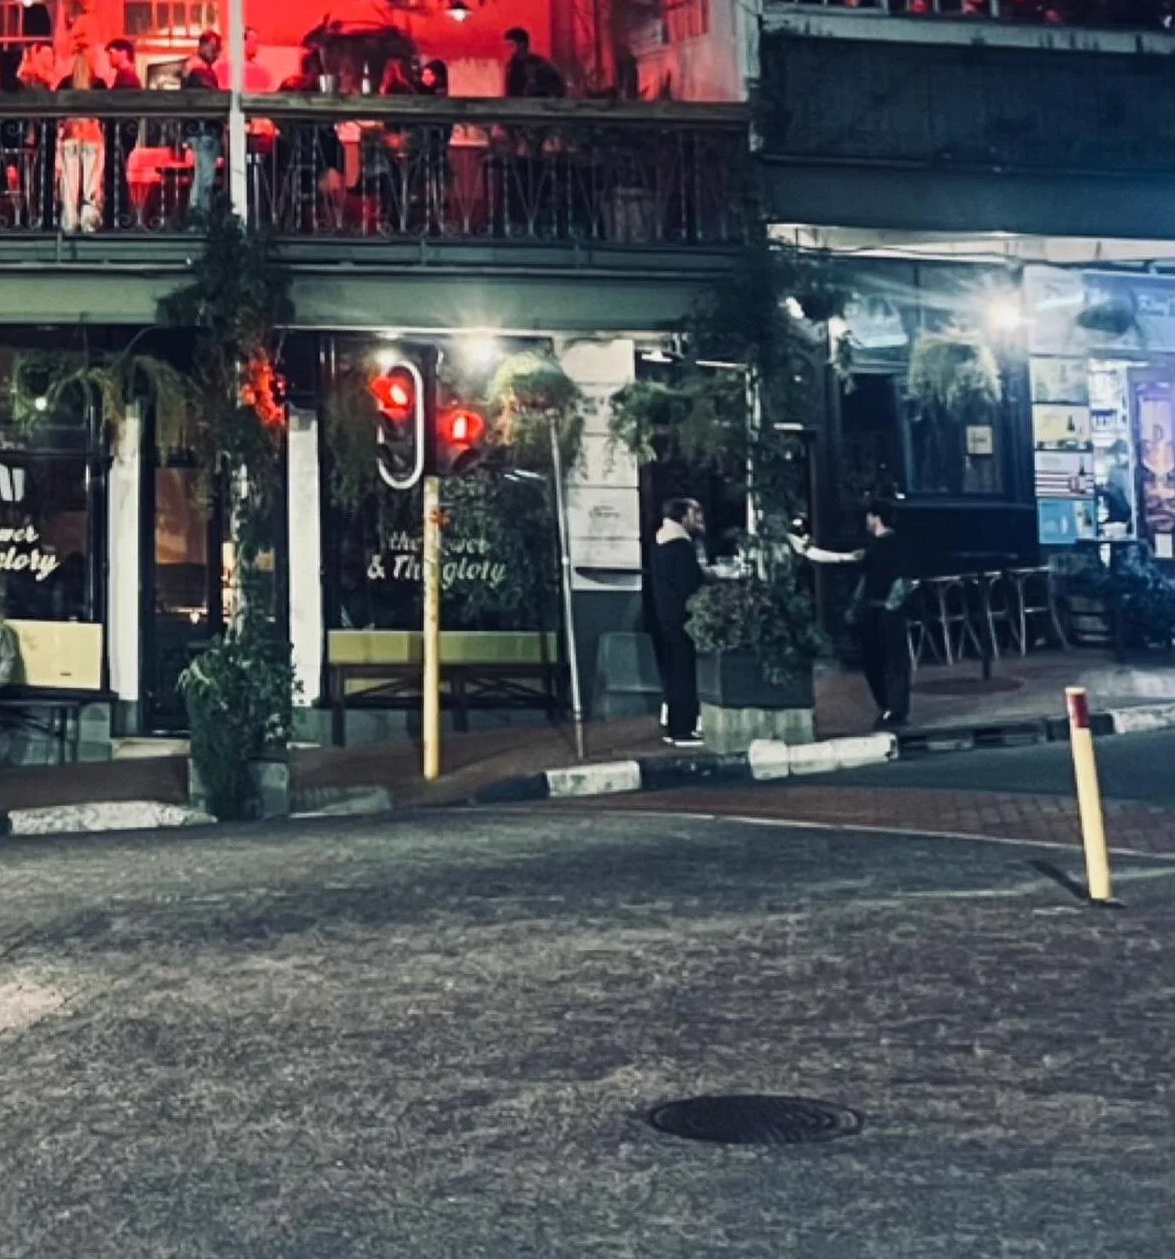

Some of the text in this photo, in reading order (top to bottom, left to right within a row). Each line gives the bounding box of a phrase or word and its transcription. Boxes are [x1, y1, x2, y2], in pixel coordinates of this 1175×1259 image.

[367, 555, 506, 590] & Th glory
